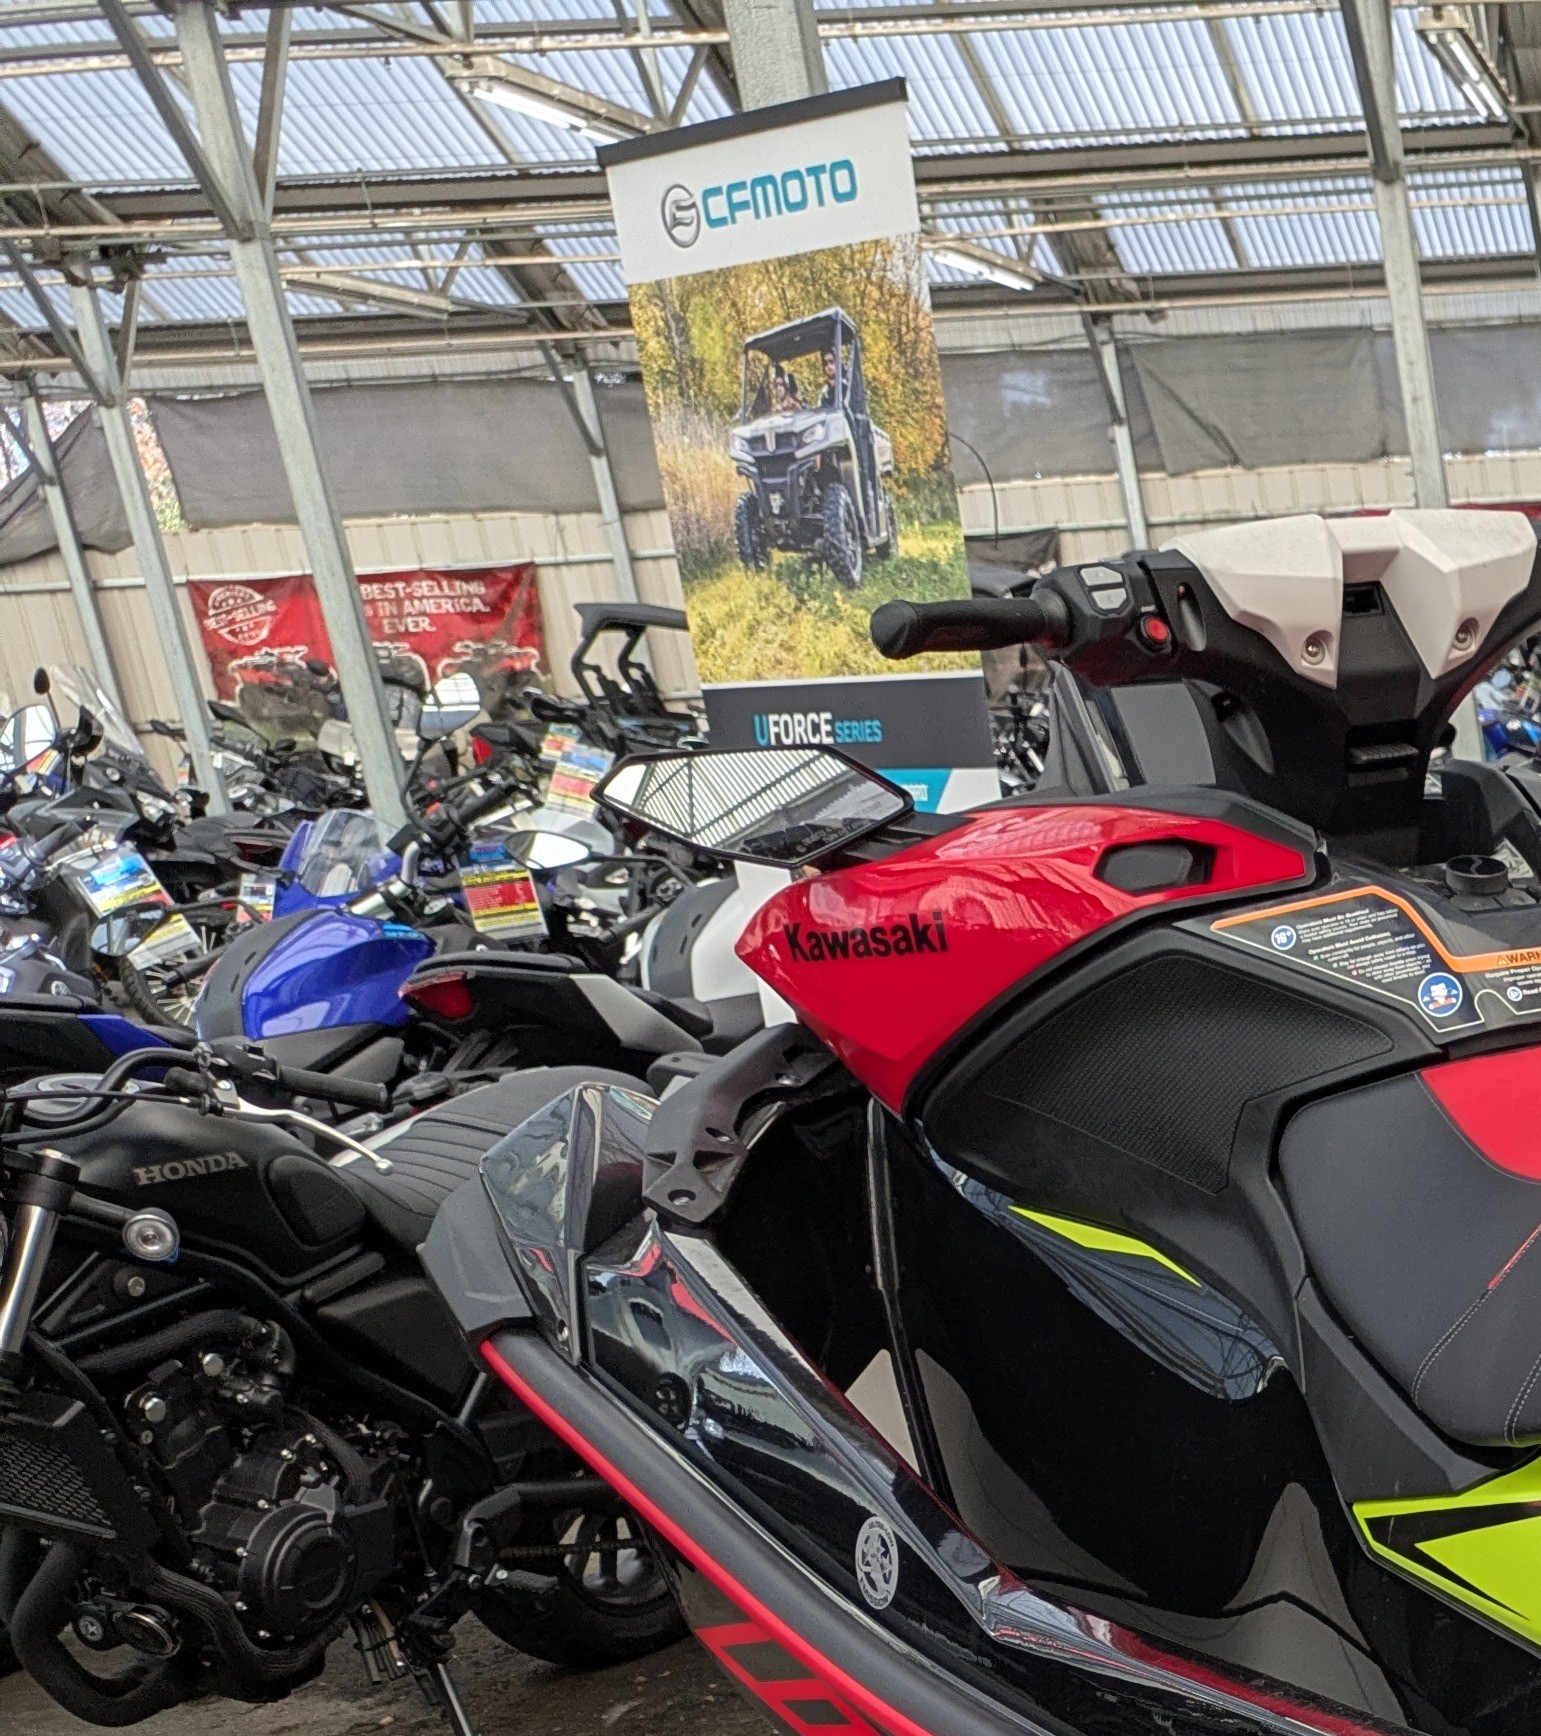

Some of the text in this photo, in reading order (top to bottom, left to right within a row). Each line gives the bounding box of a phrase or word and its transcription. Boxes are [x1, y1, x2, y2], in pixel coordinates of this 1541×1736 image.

[702, 159, 858, 229] CFMOTO
[360, 580, 487, 601] BEST-SELLING
[377, 601, 400, 617] IN
[404, 598, 491, 614] AMERICA.
[383, 616, 437, 633] EVER.
[835, 719, 883, 744] SERIES
[784, 911, 949, 964] Kawasaki
[133, 1151, 249, 1186] HONDA
